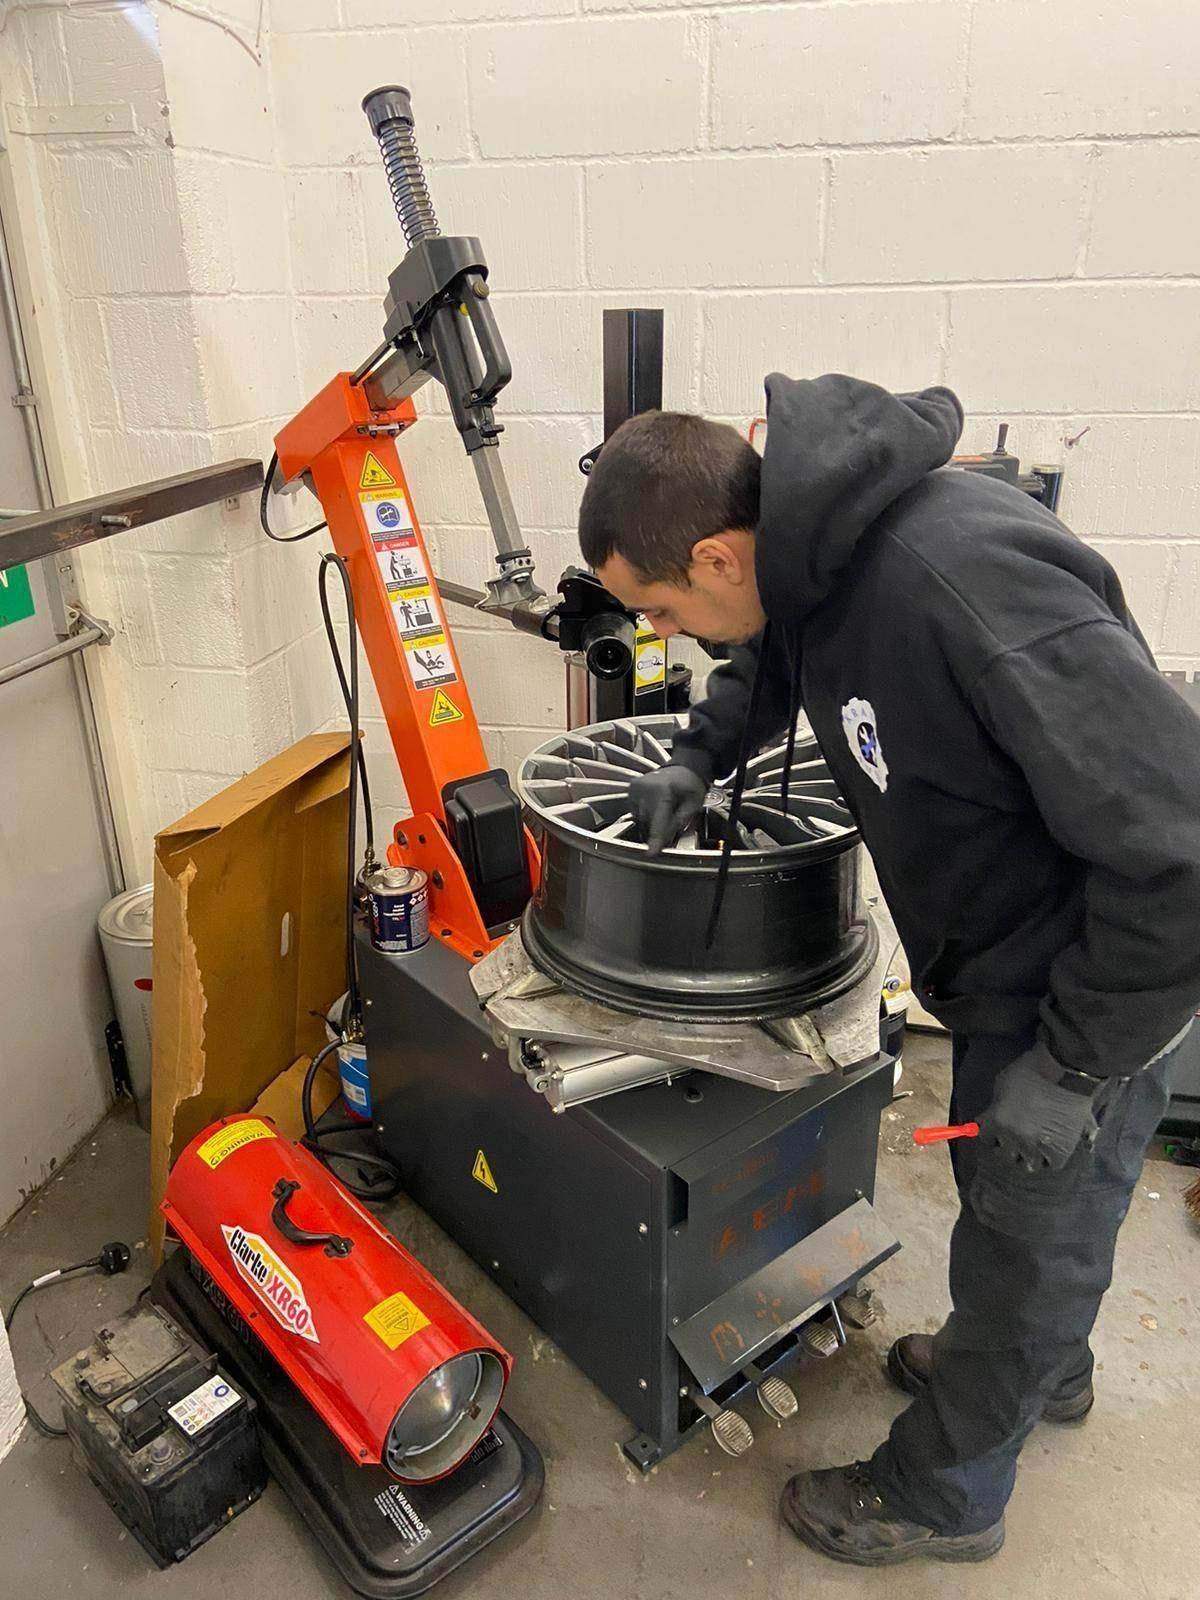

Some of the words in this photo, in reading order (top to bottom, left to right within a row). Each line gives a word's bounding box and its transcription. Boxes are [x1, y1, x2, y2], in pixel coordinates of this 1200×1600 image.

[230, 1229, 268, 1283] Clarke
[267, 1275, 309, 1330] XR60
[396, 1491, 424, 1531] WARNING
